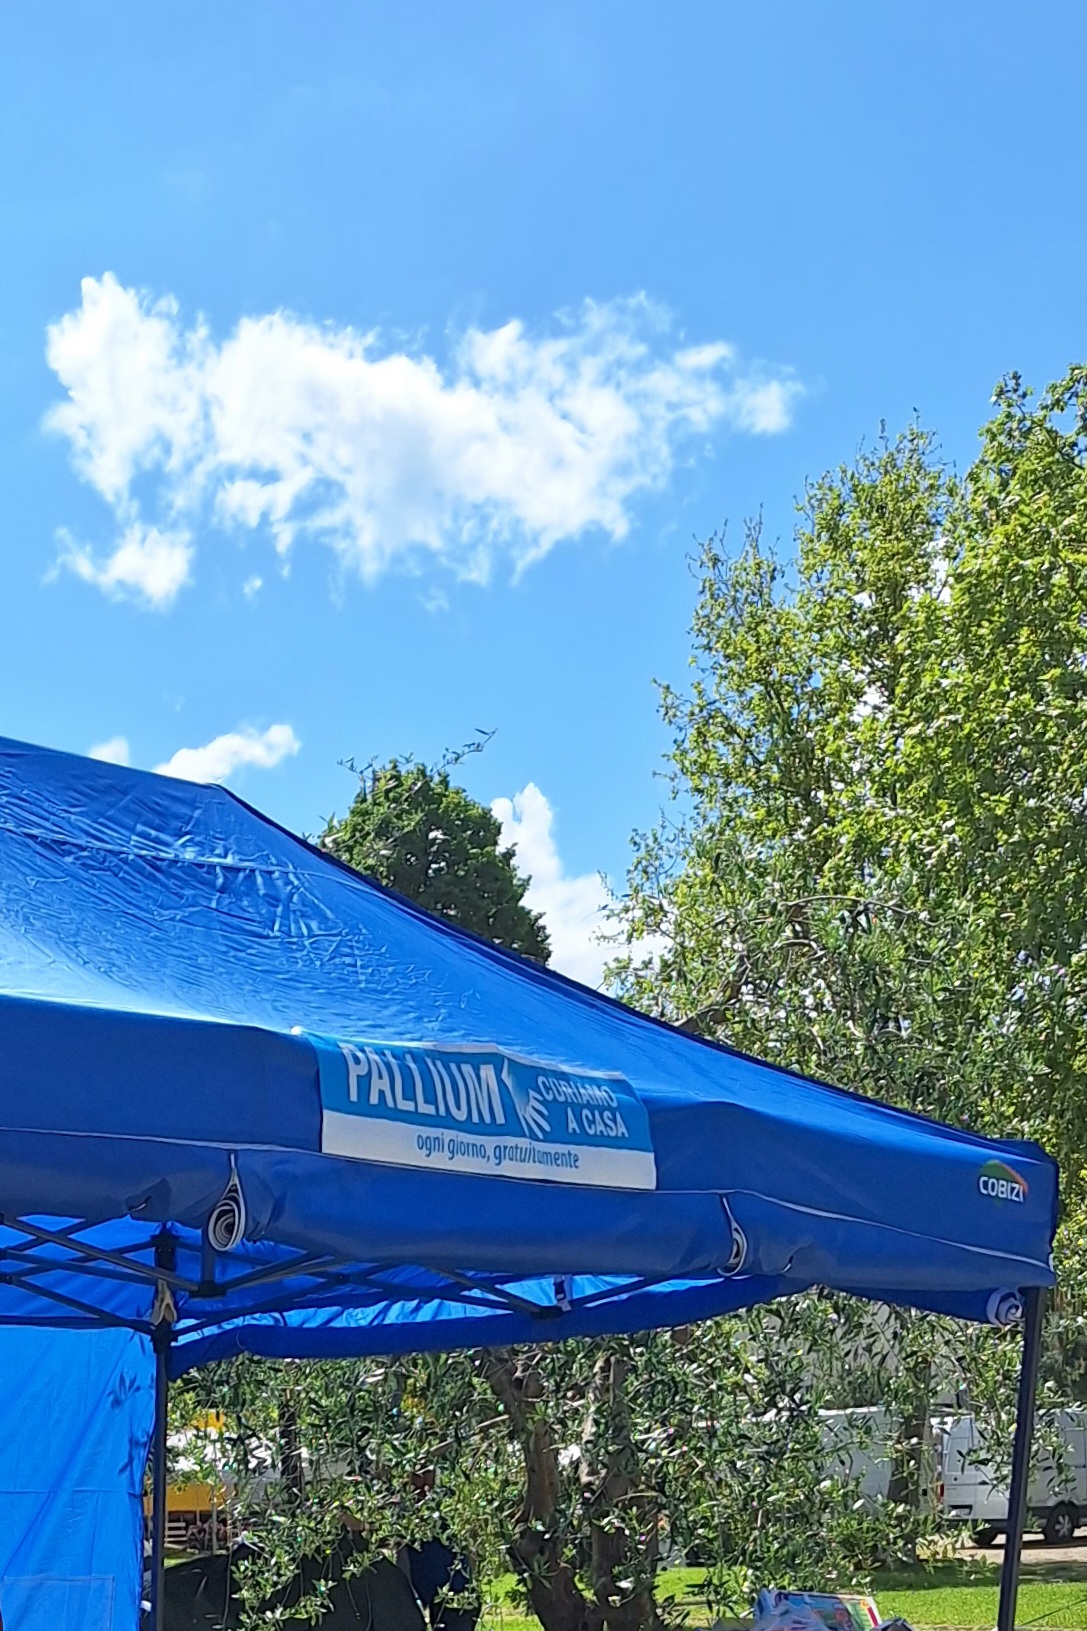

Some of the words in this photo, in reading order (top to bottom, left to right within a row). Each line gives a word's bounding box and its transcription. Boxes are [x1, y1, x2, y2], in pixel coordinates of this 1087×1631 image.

[337, 1041, 506, 1125] PALLIUM
[537, 1075, 618, 1108] CURIAMO
[566, 1106, 579, 1134] A
[581, 1110, 629, 1138] CASA
[416, 1133, 444, 1158] ogni
[447, 1136, 490, 1164] giorno,
[493, 1141, 579, 1169] gratuitamente
[979, 1176, 1024, 1202] COBIZI
